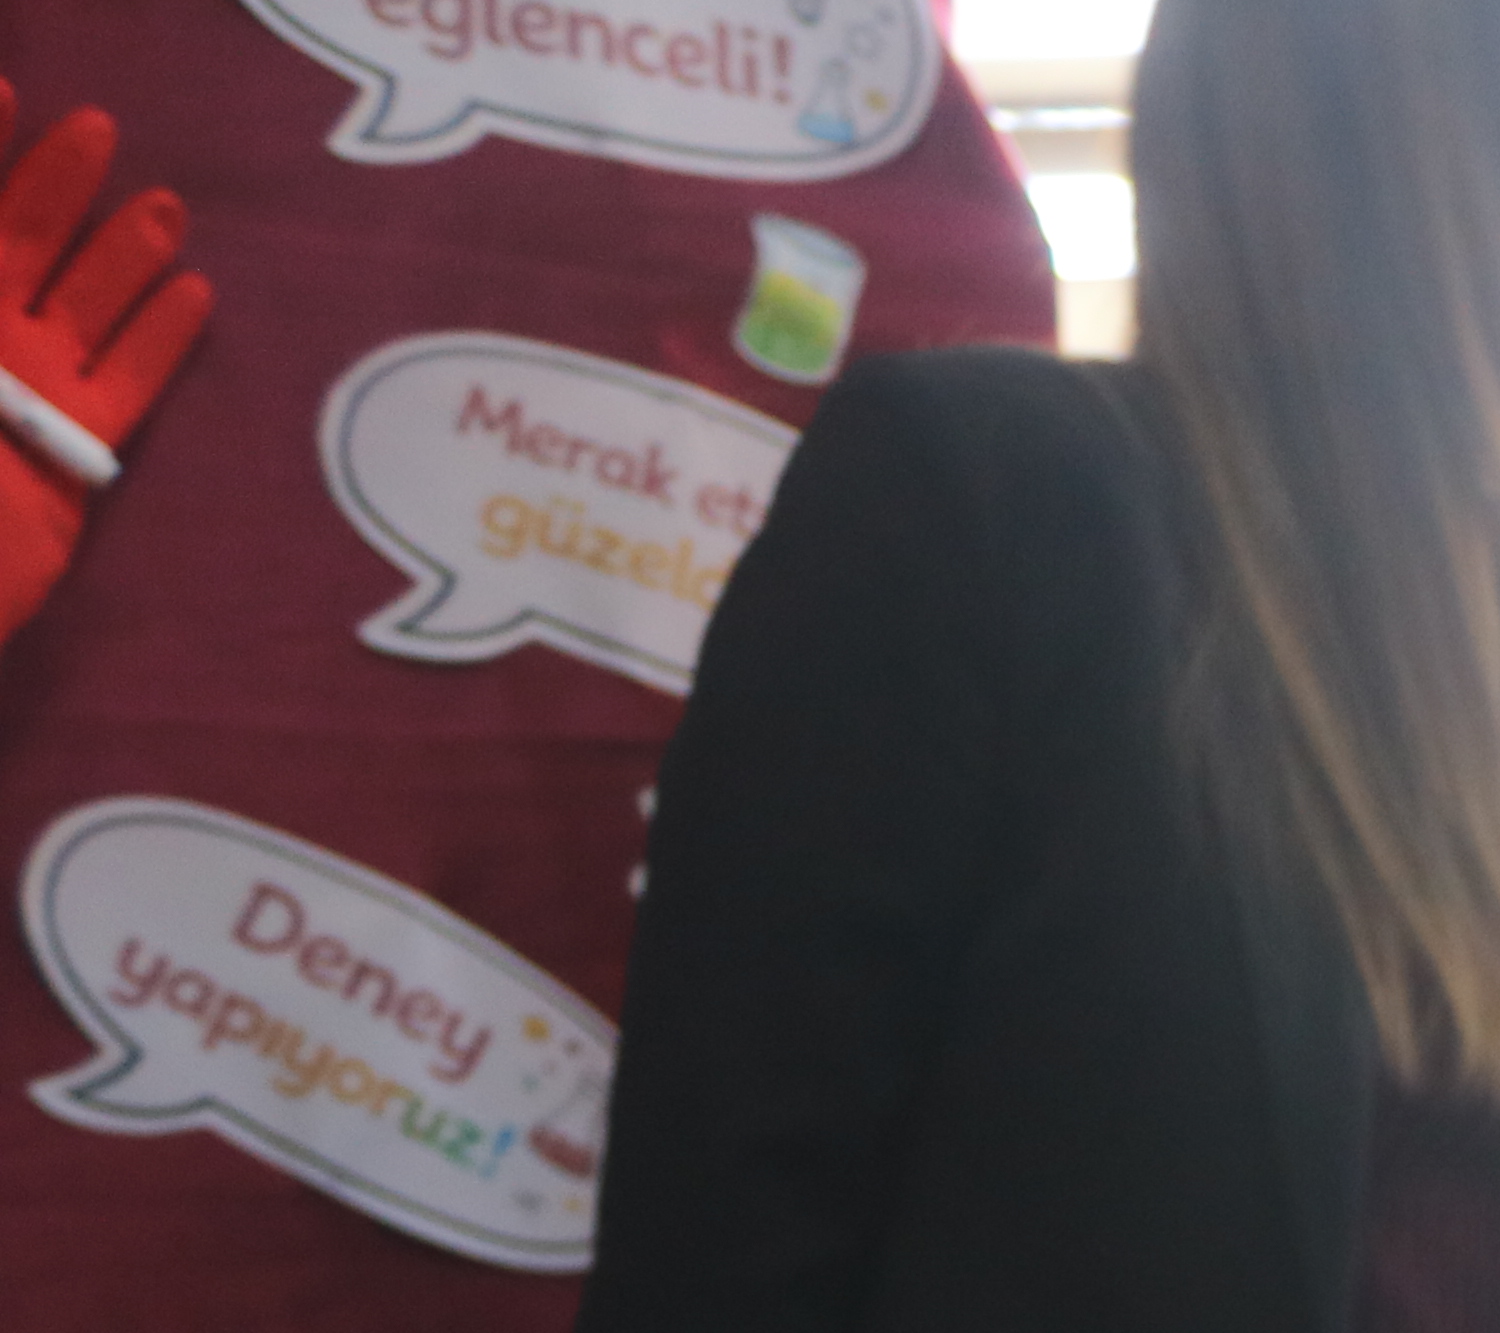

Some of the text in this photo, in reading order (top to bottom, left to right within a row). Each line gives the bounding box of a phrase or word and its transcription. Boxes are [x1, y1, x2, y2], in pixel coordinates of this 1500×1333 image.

[456, 383, 769, 540] Merak et
[106, 936, 517, 1179] yapıyoruz!
[231, 881, 494, 1086] Deney
